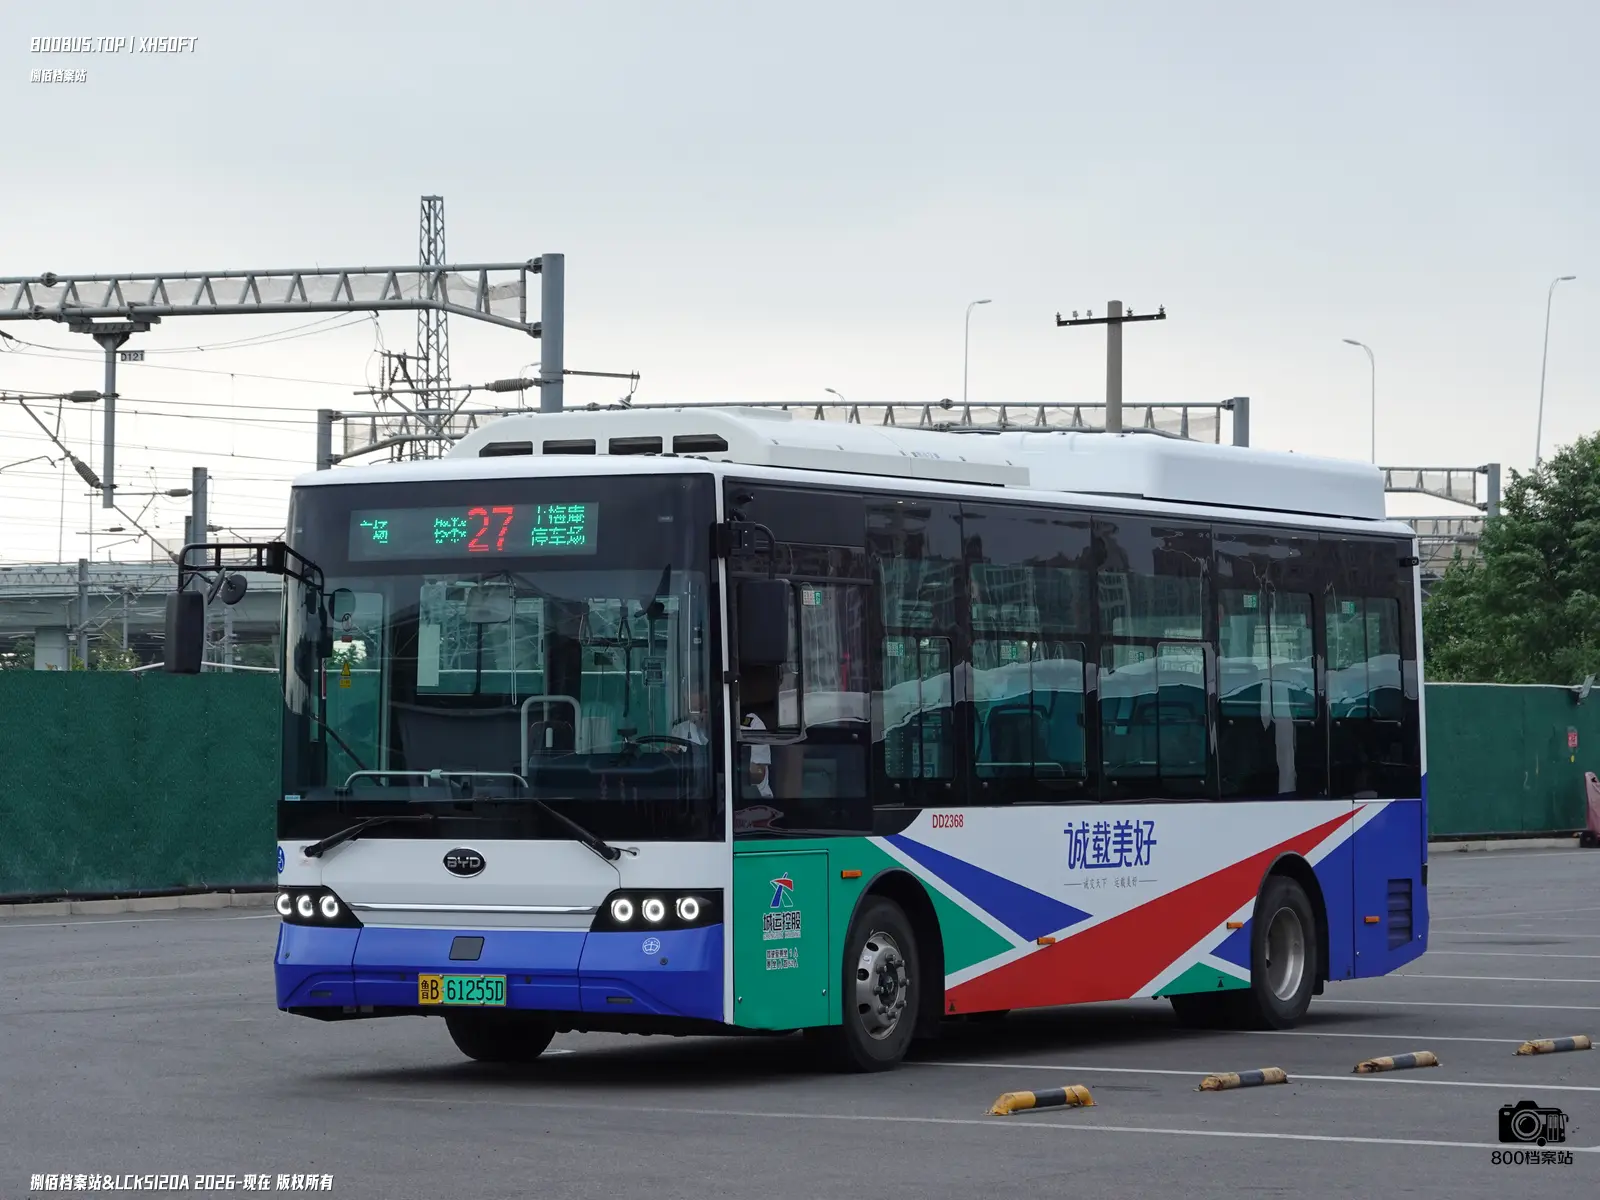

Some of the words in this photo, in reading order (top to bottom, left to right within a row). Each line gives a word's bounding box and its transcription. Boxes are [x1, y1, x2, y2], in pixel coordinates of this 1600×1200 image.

[121, 352, 144, 361] D121
[468, 506, 514, 552] 27
[531, 526, 585, 546] 停车场
[932, 814, 964, 828] DD2368
[1063, 819, 1158, 870] 诚载美好
[447, 856, 481, 868] BYD
[420, 979, 440, 1000] 鲁B
[446, 979, 505, 1001] 61255D
